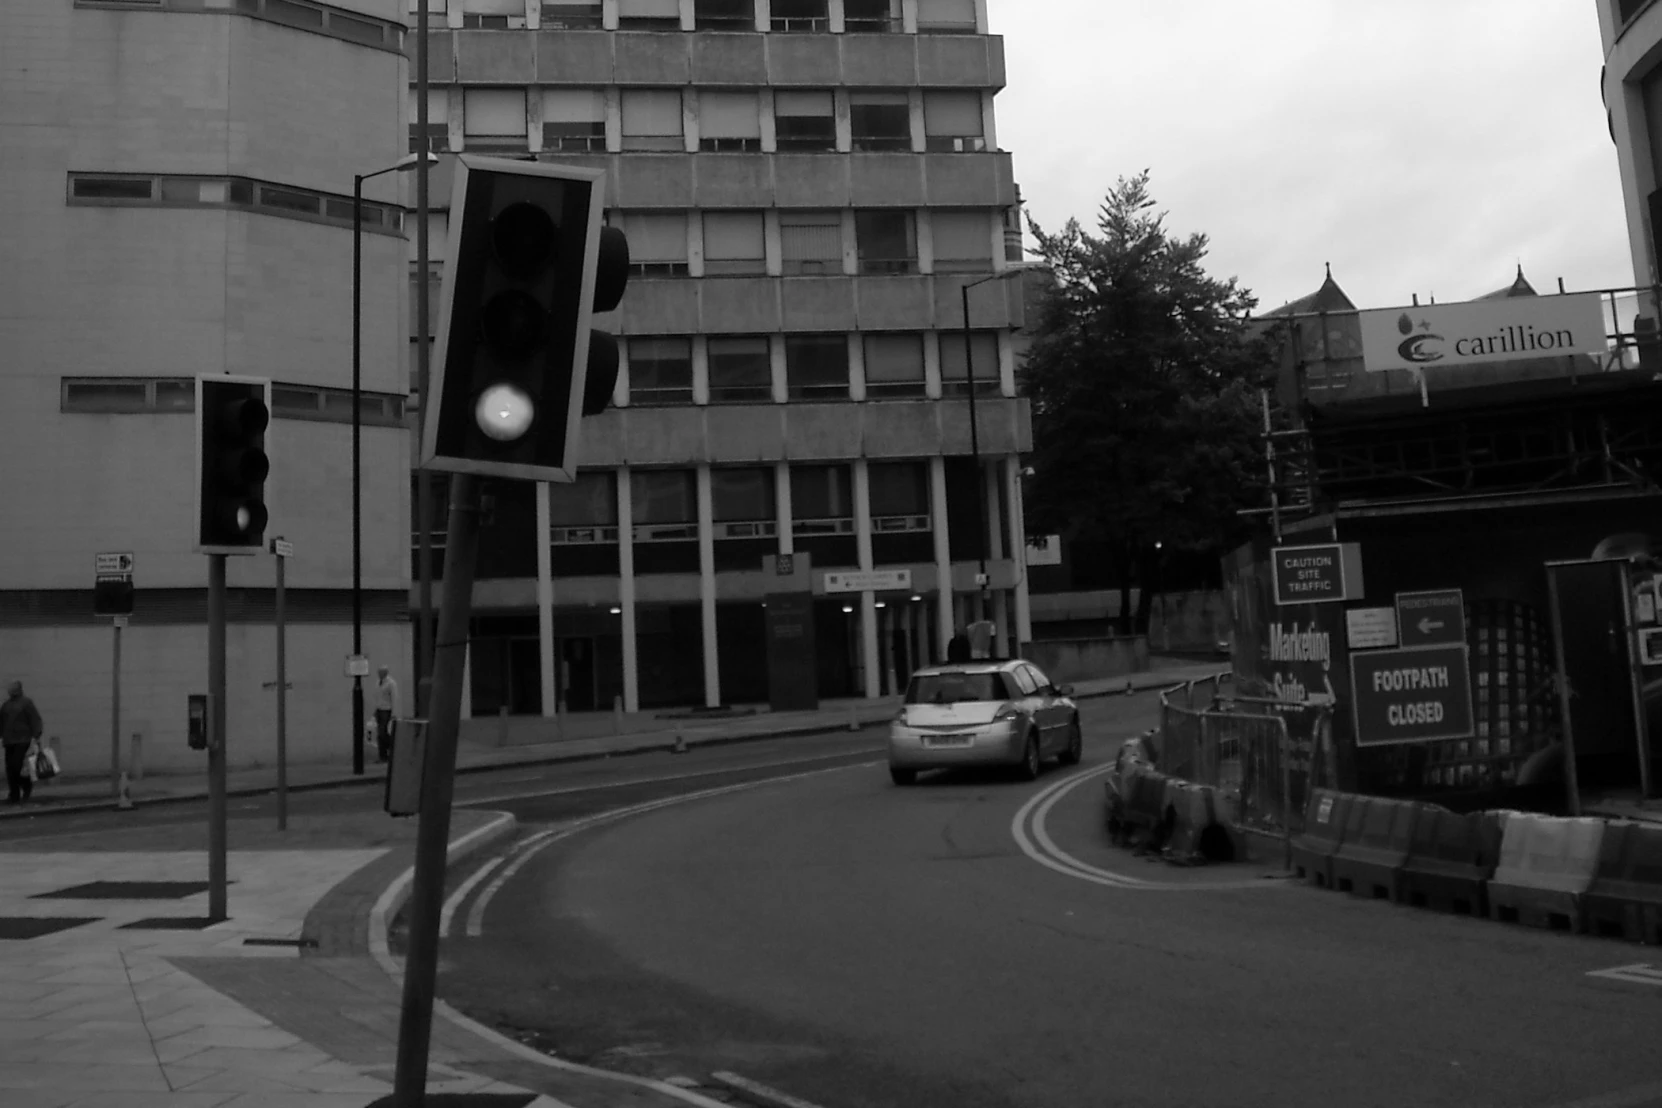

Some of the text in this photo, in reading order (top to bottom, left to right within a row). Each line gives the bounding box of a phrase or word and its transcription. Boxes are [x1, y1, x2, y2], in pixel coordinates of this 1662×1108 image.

[1455, 324, 1575, 358] carillion
[1284, 556, 1333, 569] CAUTION
[1297, 569, 1321, 581] SITE
[1288, 580, 1332, 593] TRAFFIC
[1269, 621, 1331, 672] Marketing
[1373, 665, 1449, 693] FOOTPATH
[1388, 701, 1444, 727] CLOSED
